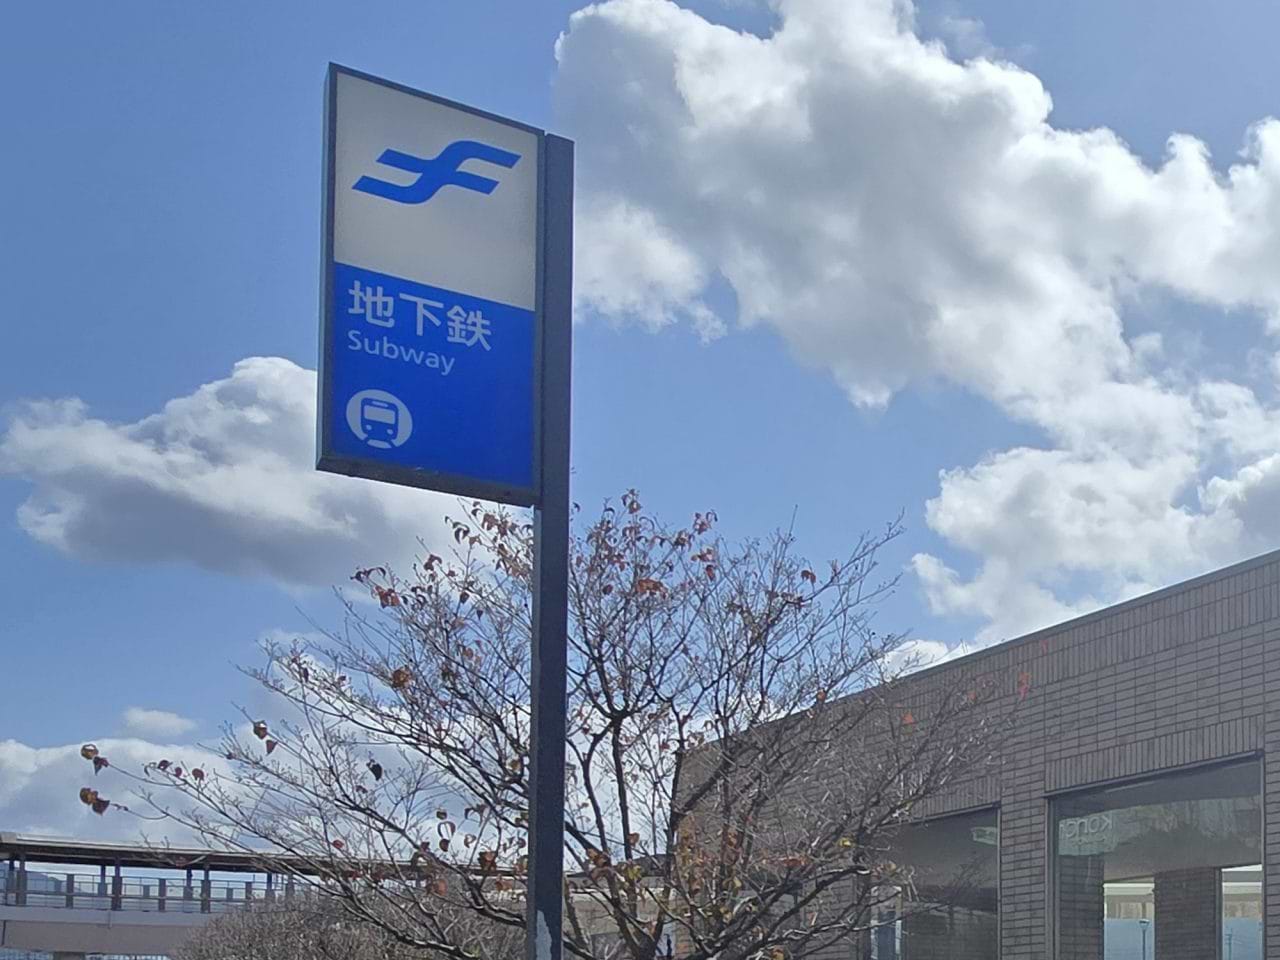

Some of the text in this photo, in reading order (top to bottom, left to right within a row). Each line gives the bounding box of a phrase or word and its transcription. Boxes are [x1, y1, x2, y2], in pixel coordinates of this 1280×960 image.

[348, 280, 492, 351] 地下鉄
[347, 329, 456, 376] Subway
